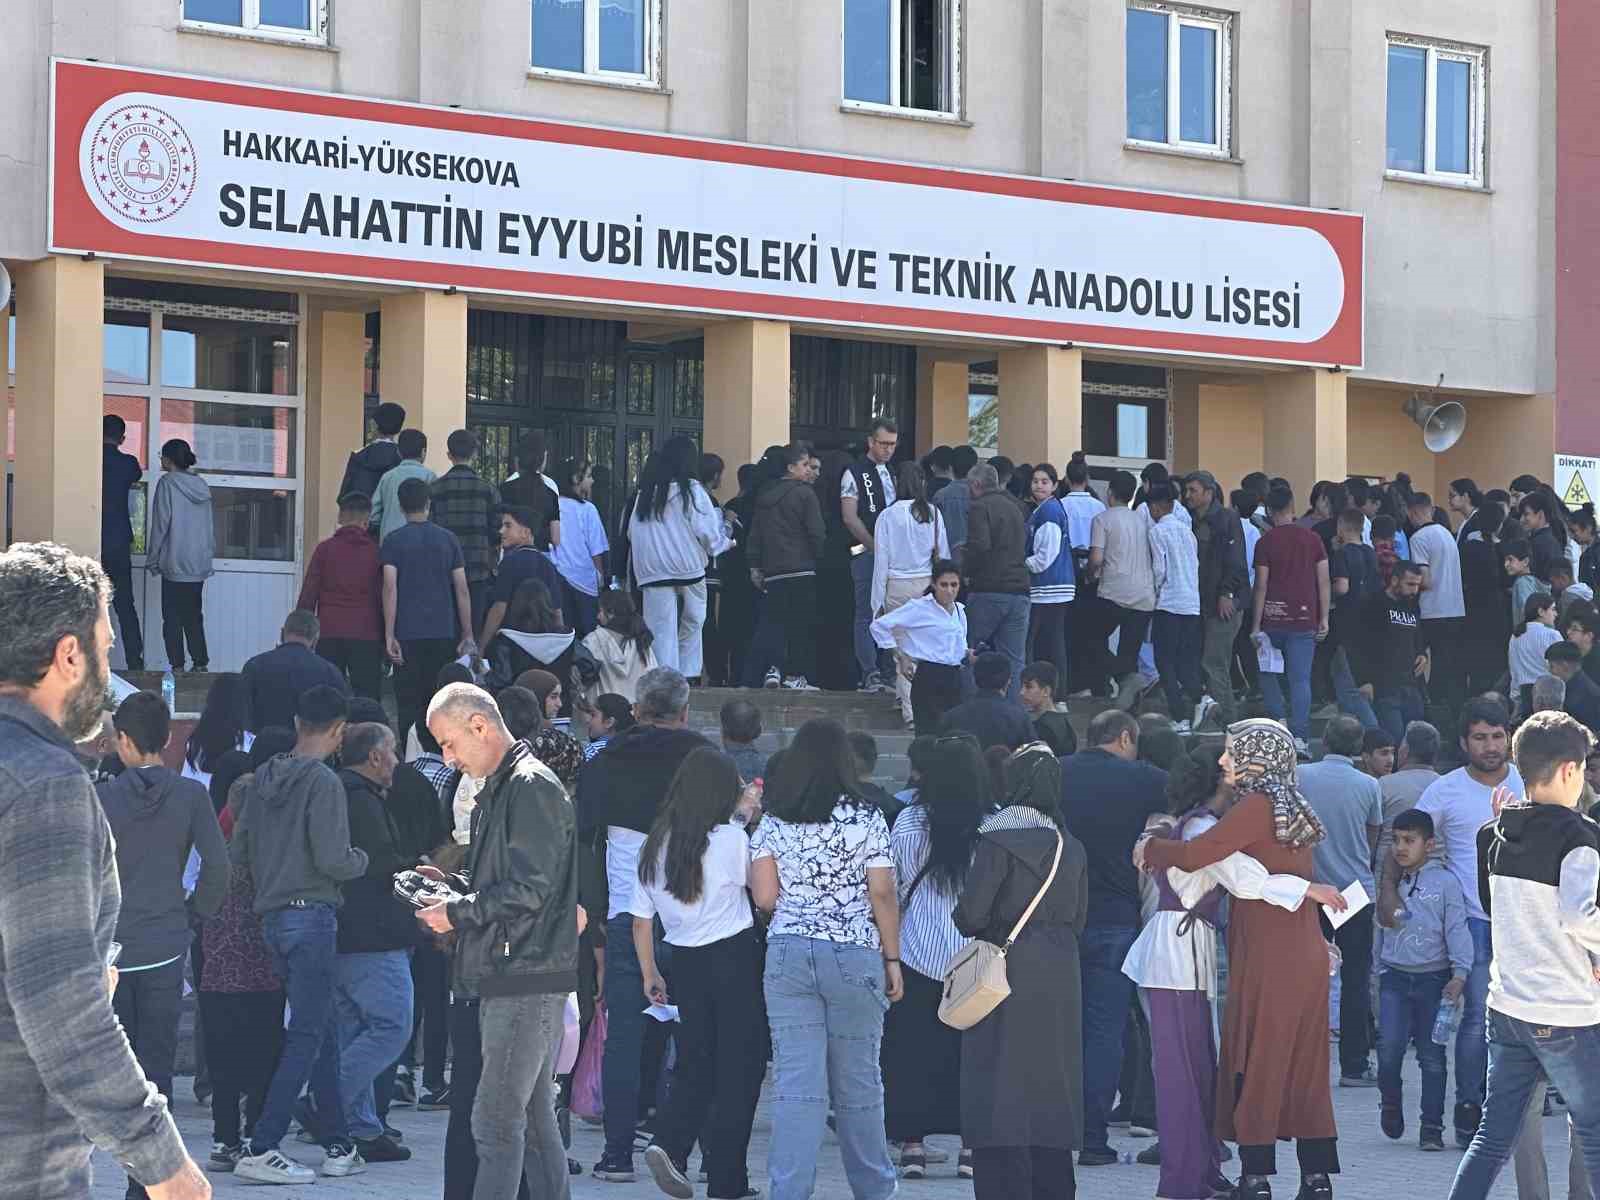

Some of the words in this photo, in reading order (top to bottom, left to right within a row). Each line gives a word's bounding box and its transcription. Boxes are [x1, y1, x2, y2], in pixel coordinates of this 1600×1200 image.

[223, 129, 520, 188] HAKKARİ-YÜKSEKOVA
[219, 183, 483, 251] SELAHATTİN
[498, 212, 643, 267] EYYUBİ
[657, 228, 818, 284] MESLEKİ
[830, 246, 877, 290] VE
[888, 252, 1017, 304] TEKNİK
[1027, 268, 1193, 320] ANADOLU
[1205, 275, 1300, 329] LİSESİ
